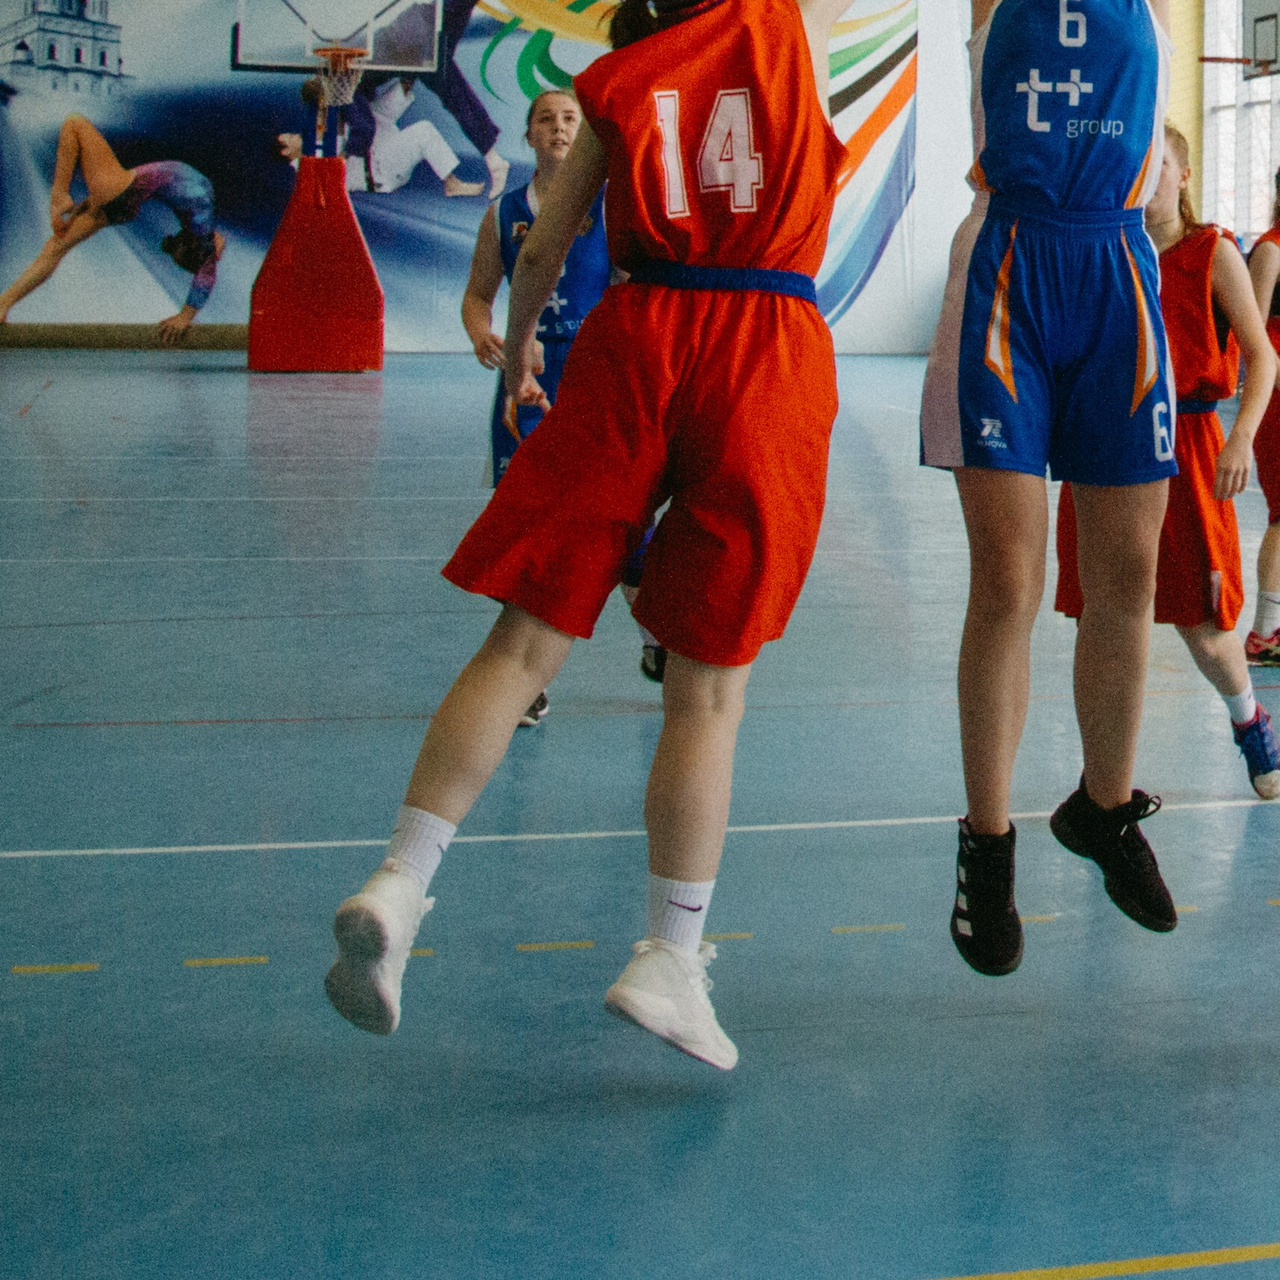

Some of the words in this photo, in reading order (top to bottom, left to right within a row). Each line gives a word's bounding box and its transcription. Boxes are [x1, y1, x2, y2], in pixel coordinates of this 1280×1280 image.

[653, 87, 764, 220] 14
[1066, 118, 1125, 139] group
[1152, 401, 1174, 463] 6
